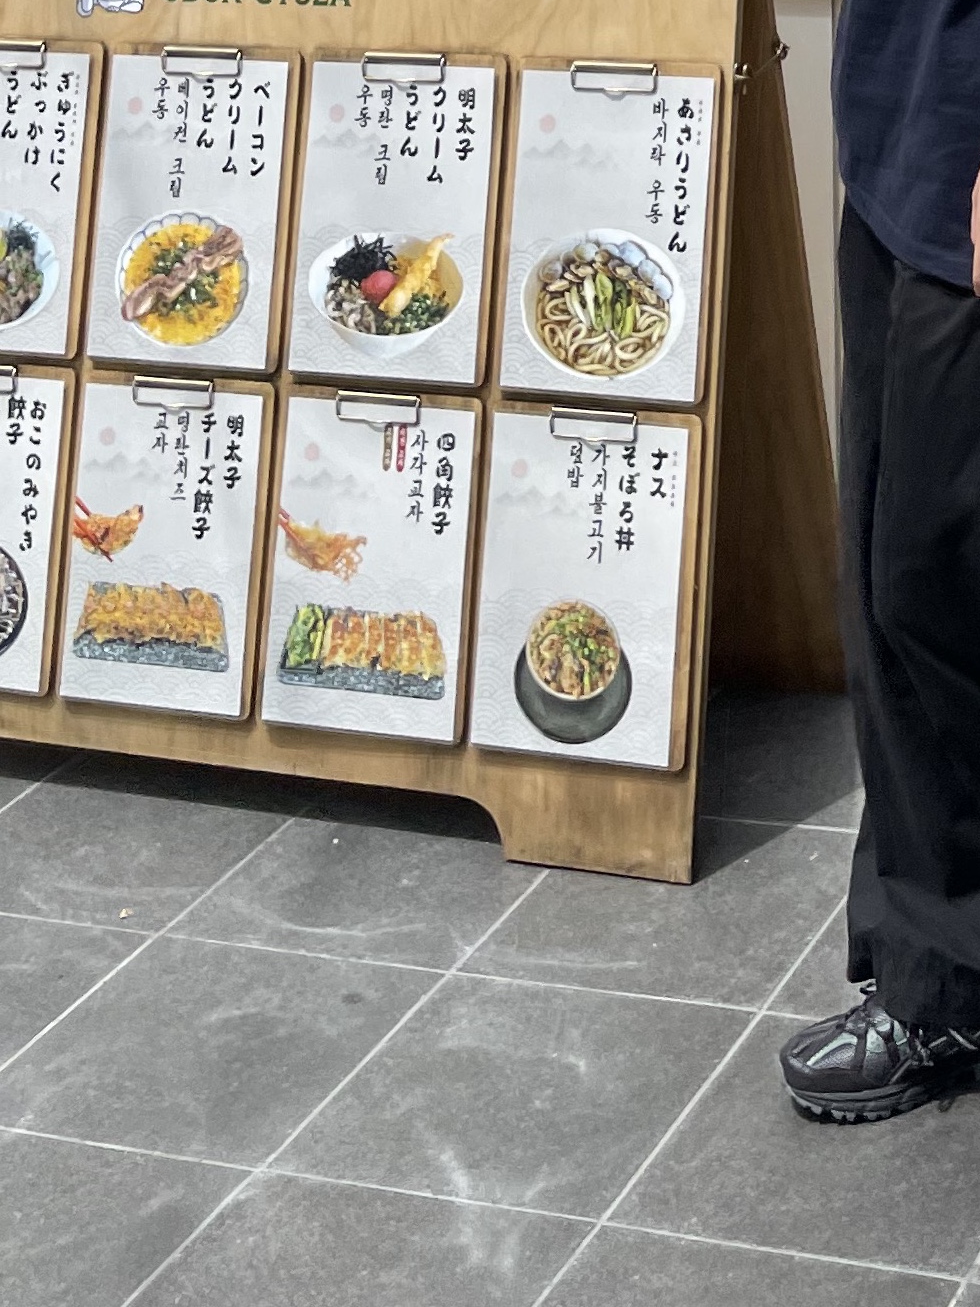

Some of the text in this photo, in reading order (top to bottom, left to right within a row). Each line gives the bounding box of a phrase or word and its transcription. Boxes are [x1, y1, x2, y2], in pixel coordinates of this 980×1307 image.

[1, 70, 21, 139] うどん
[152, 77, 170, 120] 우동
[168, 77, 190, 198] 베이컨 크림
[196, 78, 218, 148] うどん
[222, 78, 243, 175] クリーム
[250, 81, 271, 176] ベーコン
[354, 84, 374, 128] 우동
[374, 85, 394, 185] 명란 크림
[400, 84, 422, 157] うどん
[427, 86, 447, 184] クリーム
[455, 87, 476, 161] 明太子
[645, 98, 669, 224] 바지락 우동
[668, 98, 694, 253] あさりうどん
[6, 396, 28, 445] 餃子
[151, 412, 169, 454] 교자
[223, 415, 245, 489] 明太子
[567, 442, 584, 489] 덮밥
[19, 399, 47, 552] おこのみやき
[192, 412, 217, 540] チーズ餃子
[406, 429, 429, 523] 사각교자
[431, 432, 456, 535] 四角餃子
[586, 443, 610, 564] 가지불고기
[615, 445, 640, 551] そぼろ丼
[650, 447, 669, 499] ナス
